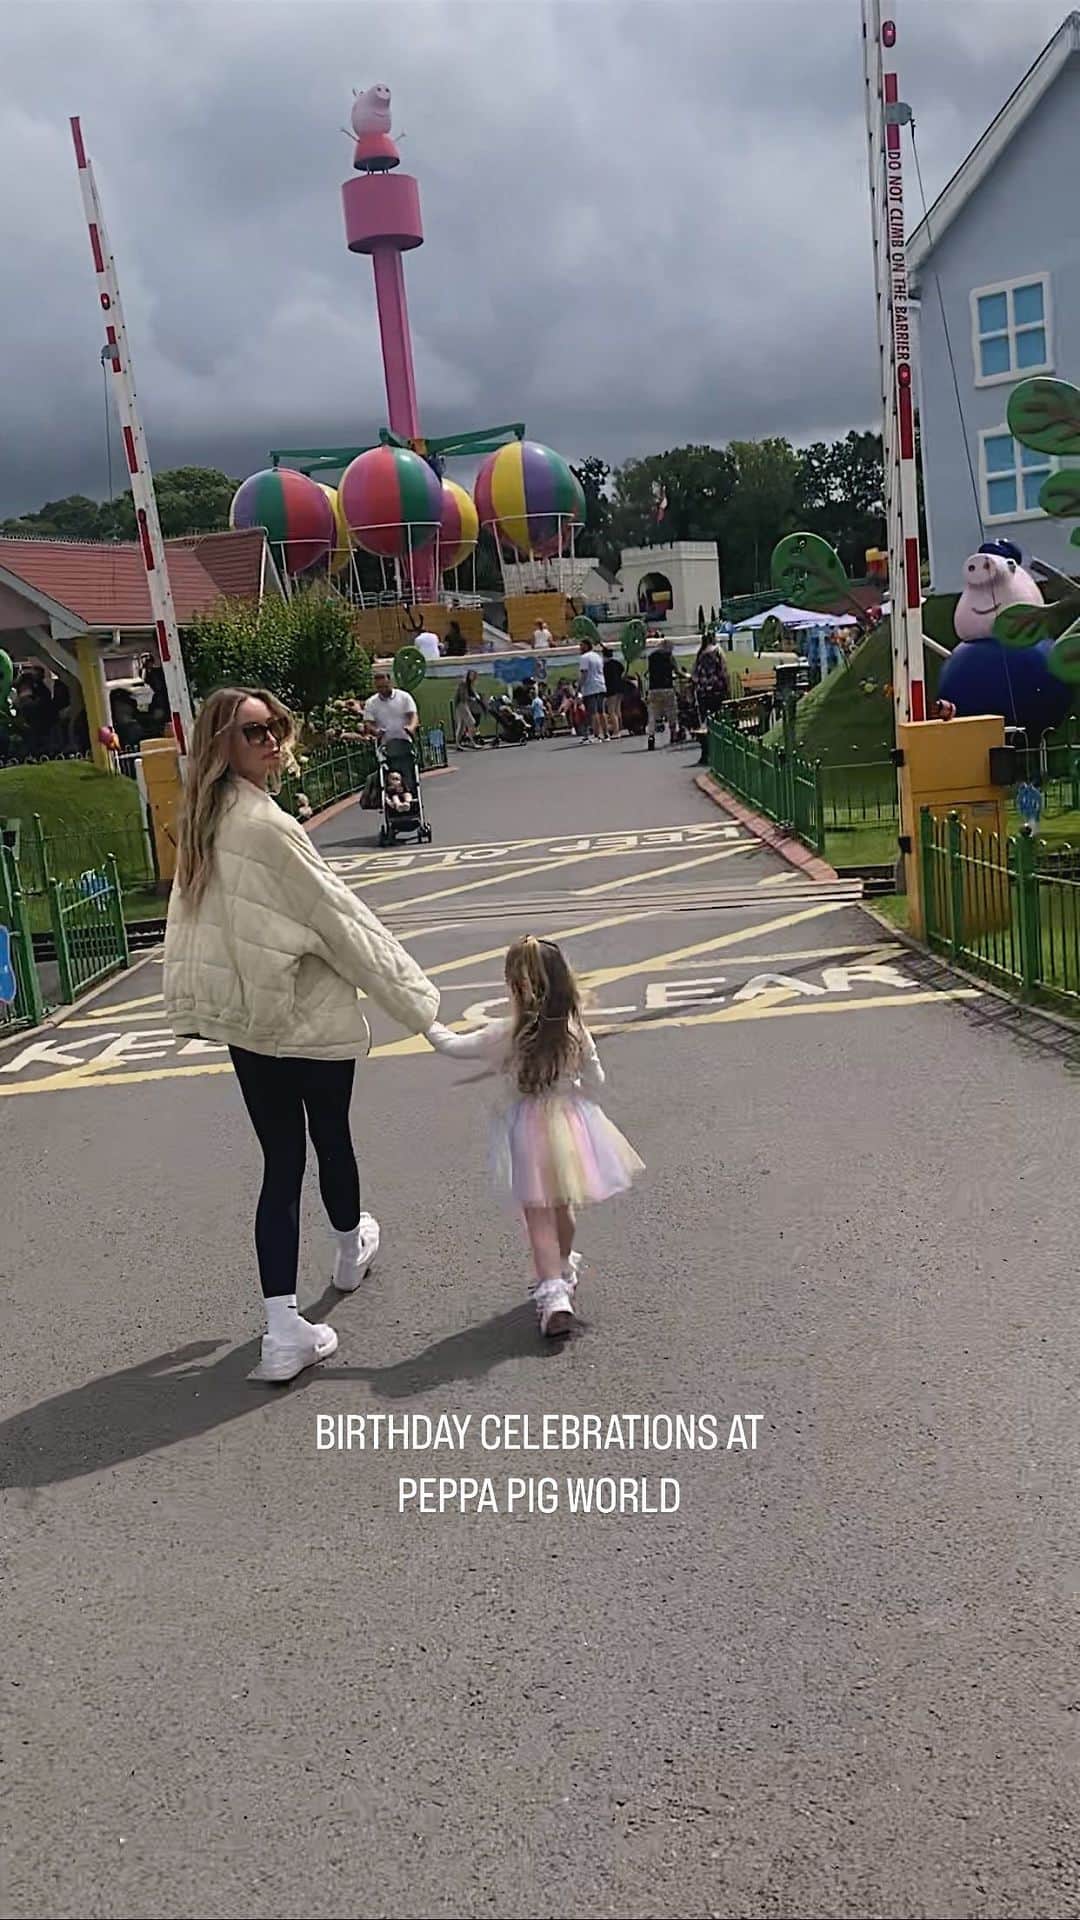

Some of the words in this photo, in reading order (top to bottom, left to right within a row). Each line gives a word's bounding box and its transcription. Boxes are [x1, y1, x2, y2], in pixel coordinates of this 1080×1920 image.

[888, 151, 902, 170] DO
[888, 175, 903, 204] NOT
[890, 208, 905, 248] CLIMB
[892, 252, 905, 273] ON
[893, 278, 907, 301] THE
[895, 306, 910, 361] BARRIER
[548, 827, 740, 852] KEEP
[327, 848, 509, 871] CLEA
